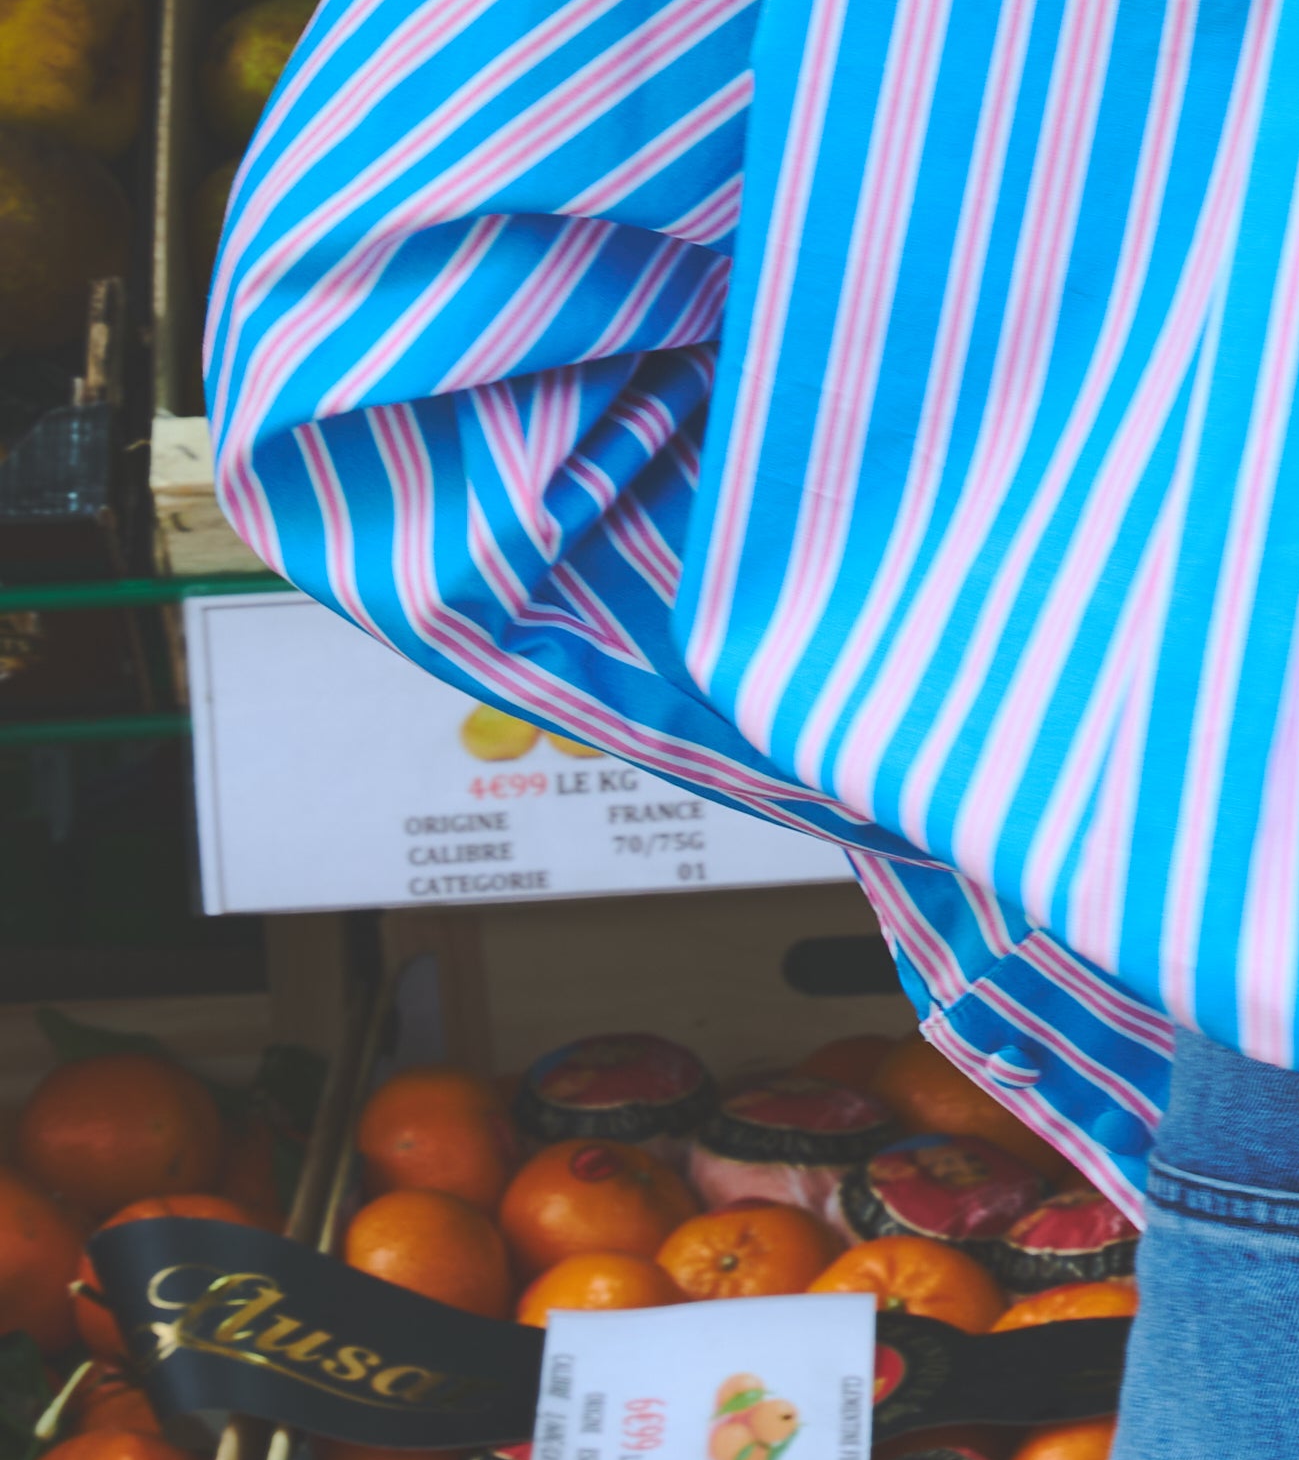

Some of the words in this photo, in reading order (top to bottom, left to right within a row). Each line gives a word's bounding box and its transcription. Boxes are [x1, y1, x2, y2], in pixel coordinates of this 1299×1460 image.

[466, 771, 549, 801] 4€99
[554, 769, 592, 795] LE
[597, 768, 640, 794] KG
[403, 811, 509, 837] ORIGINE
[607, 799, 706, 827] FRANCE
[407, 839, 514, 866] CALIBRE
[408, 867, 551, 897] CATEGORIE
